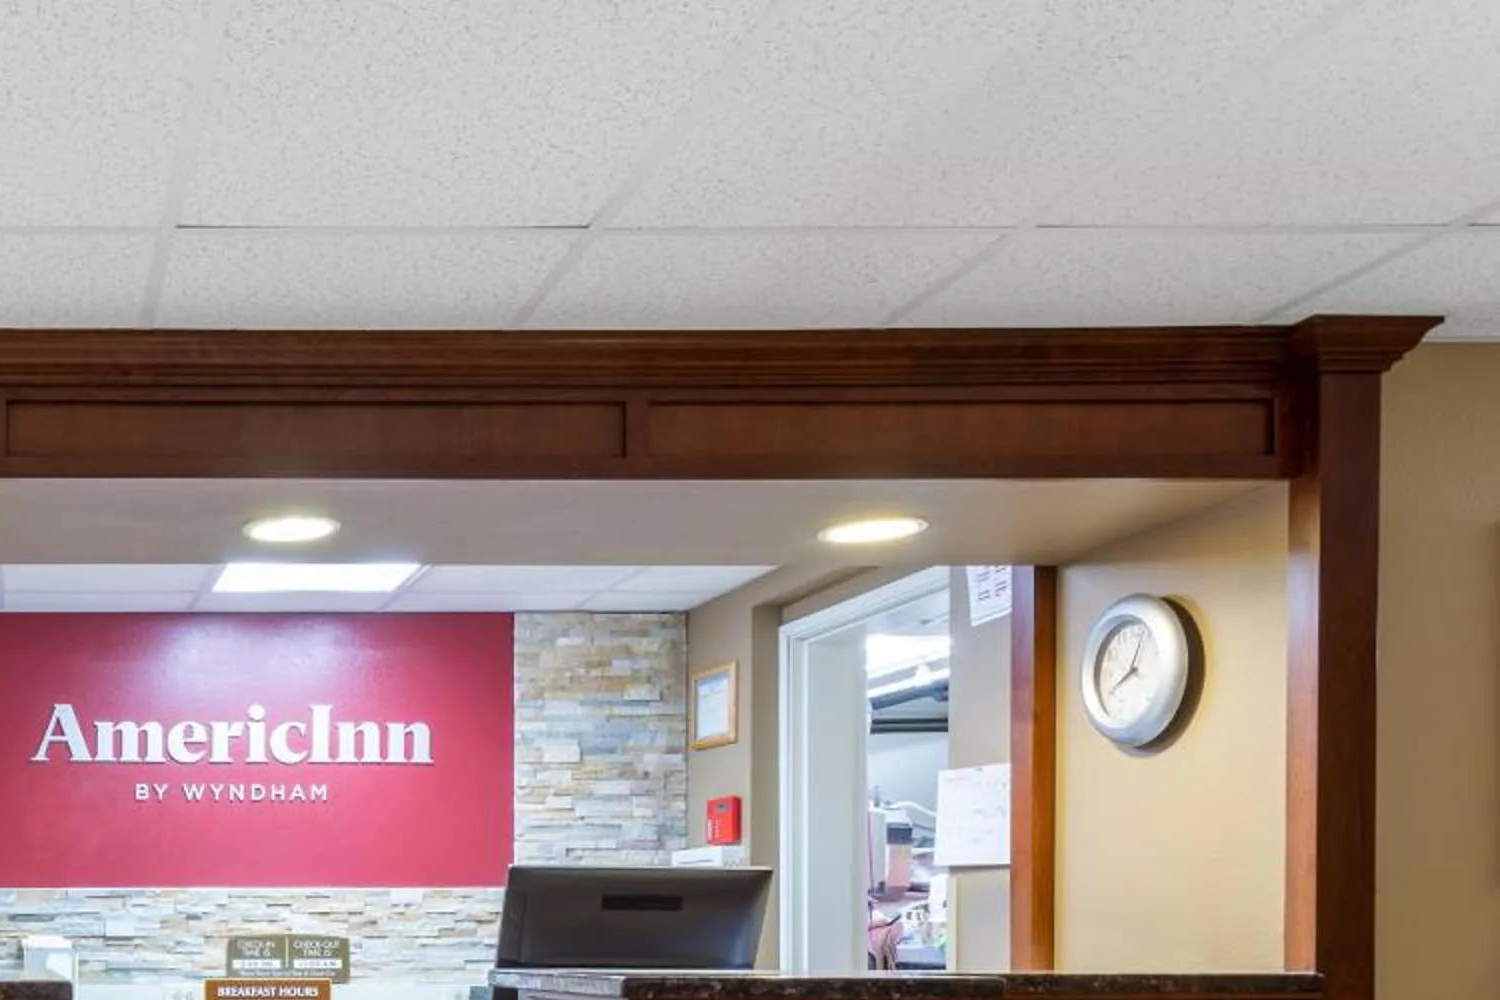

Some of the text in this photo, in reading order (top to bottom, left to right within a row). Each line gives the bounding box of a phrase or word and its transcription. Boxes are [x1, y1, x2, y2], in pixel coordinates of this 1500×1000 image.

[30, 703, 434, 764] AmericInn
[135, 783, 328, 801] BY WYNDHAM
[217, 986, 319, 997] BREAKFAST HOURS
